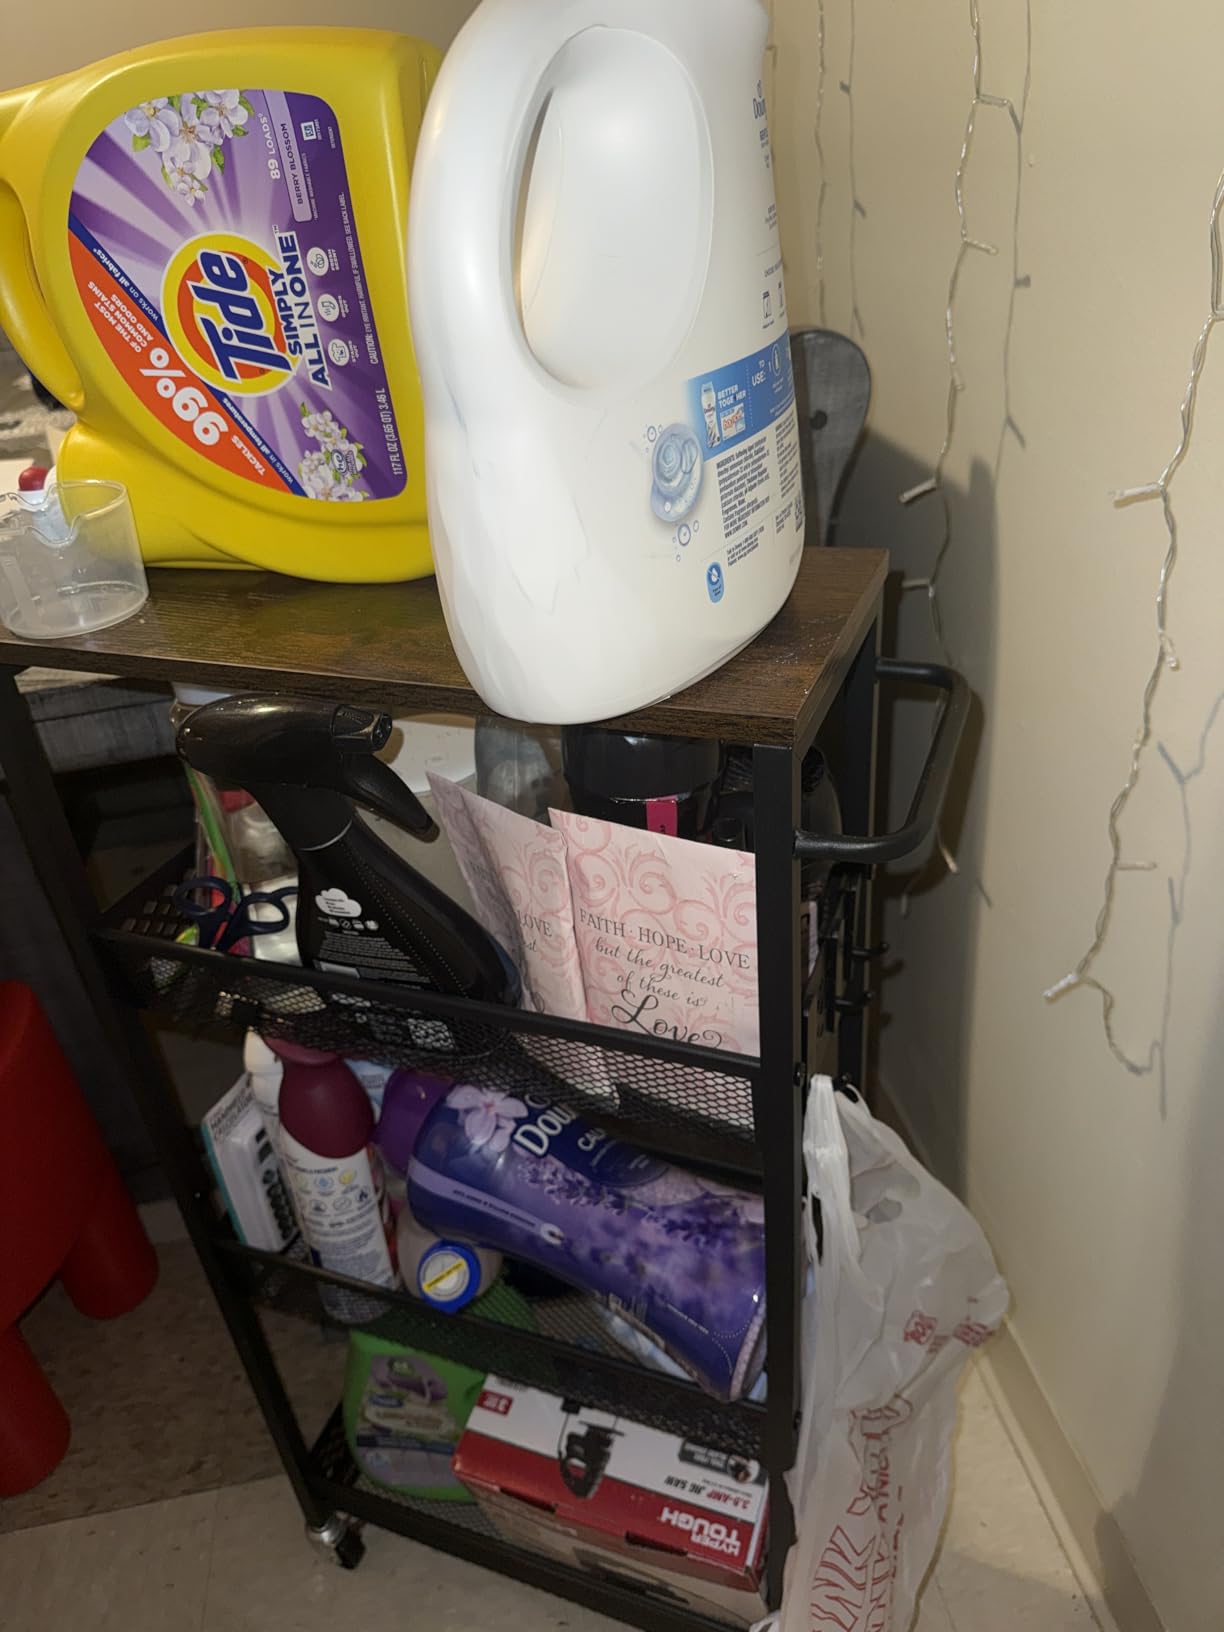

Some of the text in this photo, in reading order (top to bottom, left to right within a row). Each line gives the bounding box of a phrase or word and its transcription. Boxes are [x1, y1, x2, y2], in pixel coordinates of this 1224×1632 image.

[267, 158, 281, 180] 89
[280, 123, 303, 205] BERRY BLOSSOM
[341, 209, 349, 224] BACK
[327, 248, 335, 271] FRESH
[332, 248, 340, 271] SCENT
[119, 276, 130, 287] all
[129, 286, 140, 299] on
[87, 281, 148, 348] COMMON STAINS
[110, 294, 154, 341] AND ODORS
[138, 298, 159, 321] works
[188, 250, 294, 382] Tide
[268, 268, 303, 356] SIMPLY
[278, 233, 329, 387] ALL IN ONE
[94, 302, 142, 353] OF THE MOST
[363, 322, 372, 333] EYE
[364, 333, 379, 364] CAUTION:
[758, 360, 766, 369] TO
[139, 347, 229, 446] 99%
[375, 394, 389, 410] 3.46
[718, 384, 739, 400] BETTER
[719, 390, 747, 408] TOGEHER
[223, 397, 262, 446] temperatures
[231, 434, 266, 476] TACKLES
[260, 445, 271, 455] all
[386, 441, 398, 453] OZ
[389, 453, 401, 462] FL
[275, 462, 294, 485] works
[391, 462, 403, 476] 117
[516, 910, 553, 937] LOVE
[579, 908, 750, 970] FAITH HOPE LOVE
[595, 936, 725, 989] but the greatest
[616, 970, 706, 1007] of these is
[611, 988, 723, 1048] Love
[664, 1475, 689, 1490] SAW
[688, 1483, 706, 1496] JIG
[660, 1506, 739, 1542] TOUGH
[690, 1532, 742, 1557] HYPER
